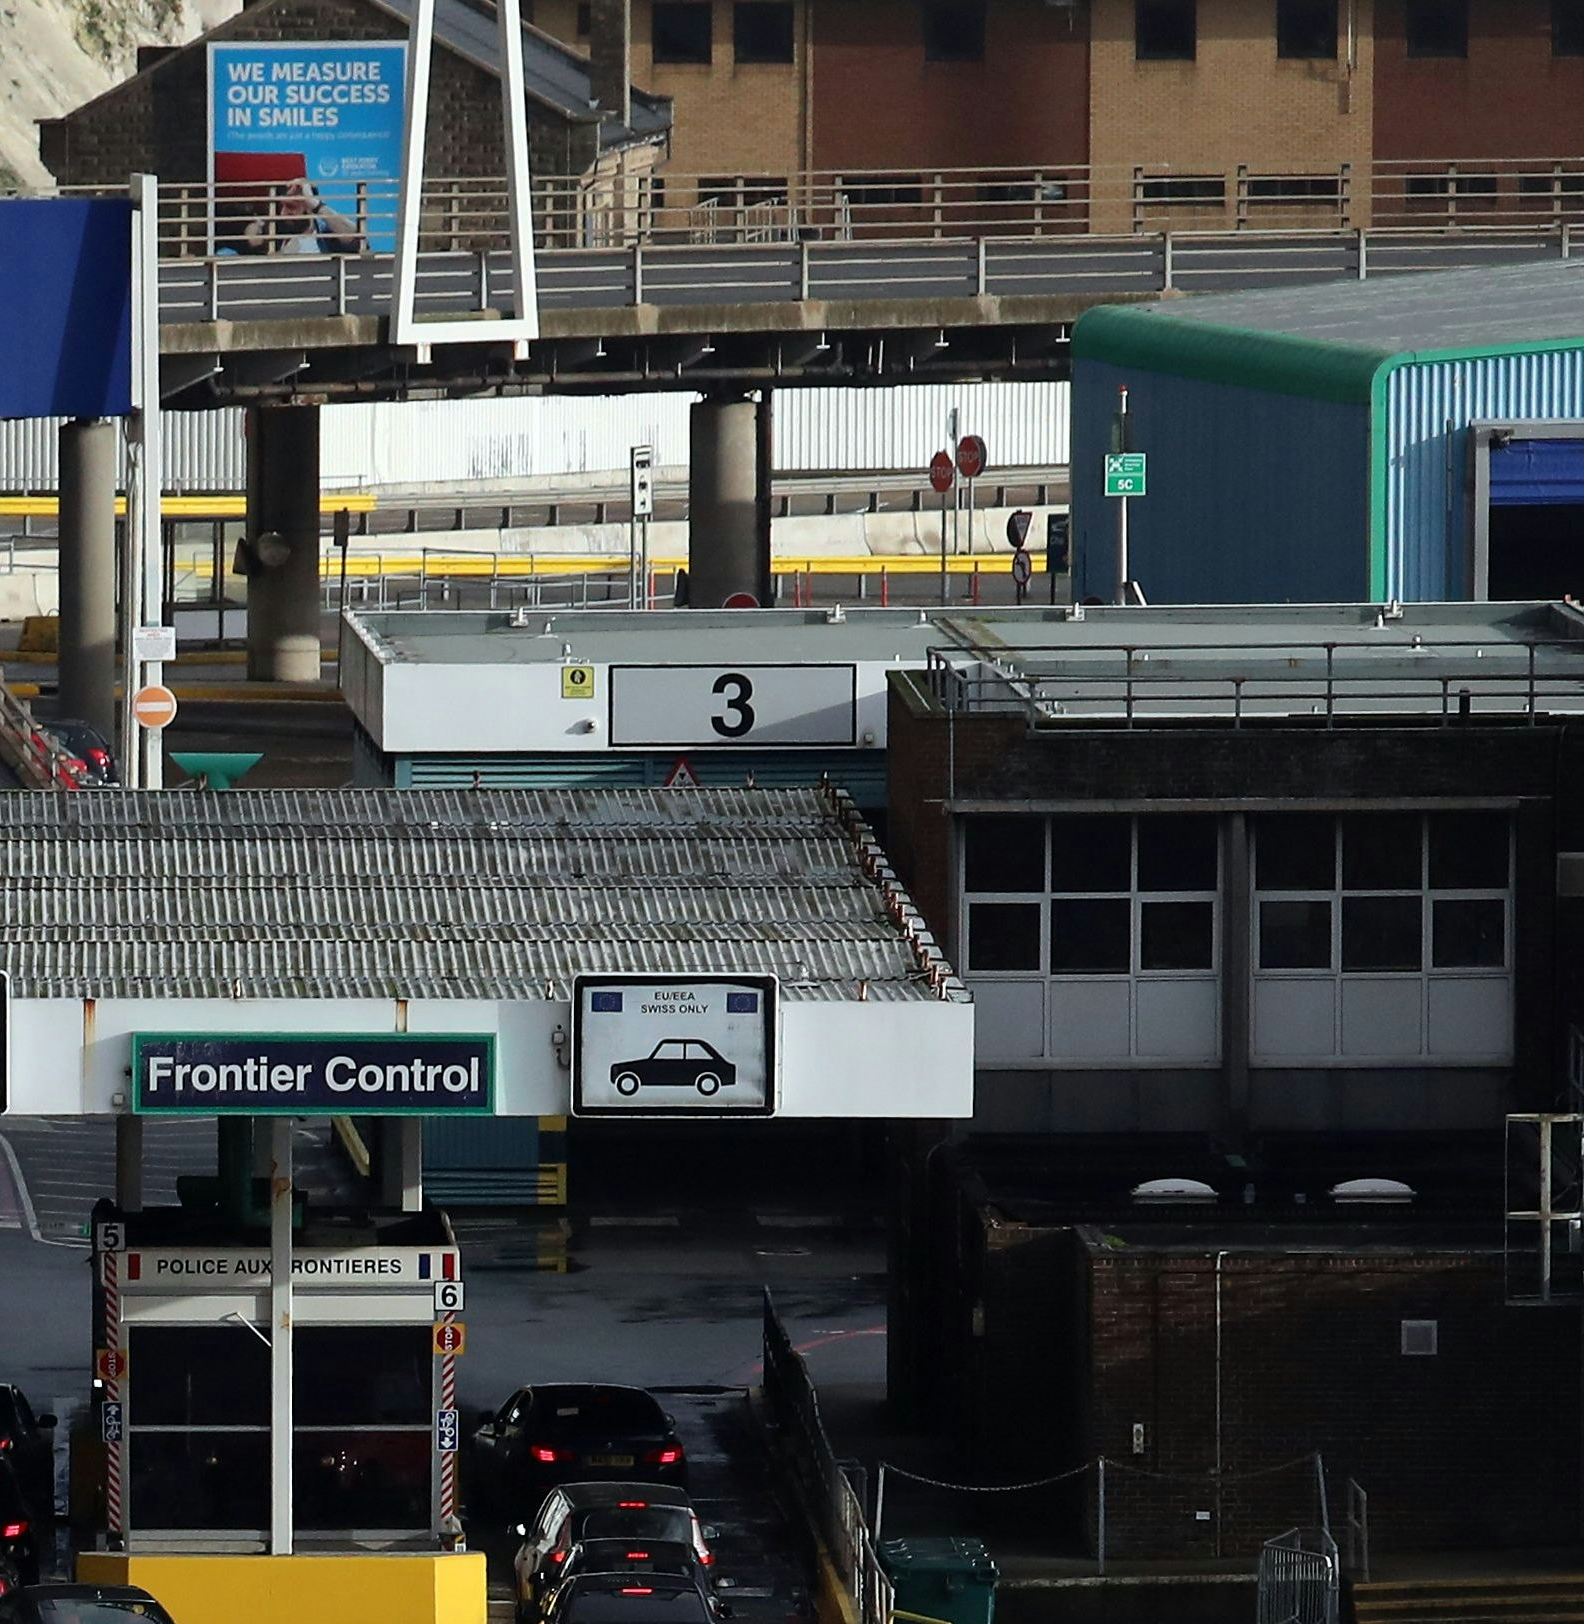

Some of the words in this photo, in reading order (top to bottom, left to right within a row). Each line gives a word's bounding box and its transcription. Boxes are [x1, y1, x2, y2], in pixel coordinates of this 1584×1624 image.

[228, 62, 264, 81] WE
[272, 62, 381, 81] MEASURE
[228, 85, 278, 104] OUR
[286, 84, 390, 104] SUCCESS
[228, 107, 251, 126] IN
[260, 107, 339, 126] SMILES
[1118, 479, 1133, 490] 5C
[710, 672, 755, 738] 3
[654, 991, 695, 1001] EU/EEA
[641, 1004, 676, 1014] SWISS
[679, 1004, 709, 1014] ONLY
[148, 1055, 310, 1092] Frontier
[325, 1055, 479, 1093] Control
[102, 1224, 120, 1248] 5
[157, 1258, 228, 1274] POLICE
[233, 1258, 272, 1274] AUX
[291, 1258, 402, 1274] RONTIERES
[441, 1284, 457, 1307] 6
[445, 1325, 454, 1350] STOP
